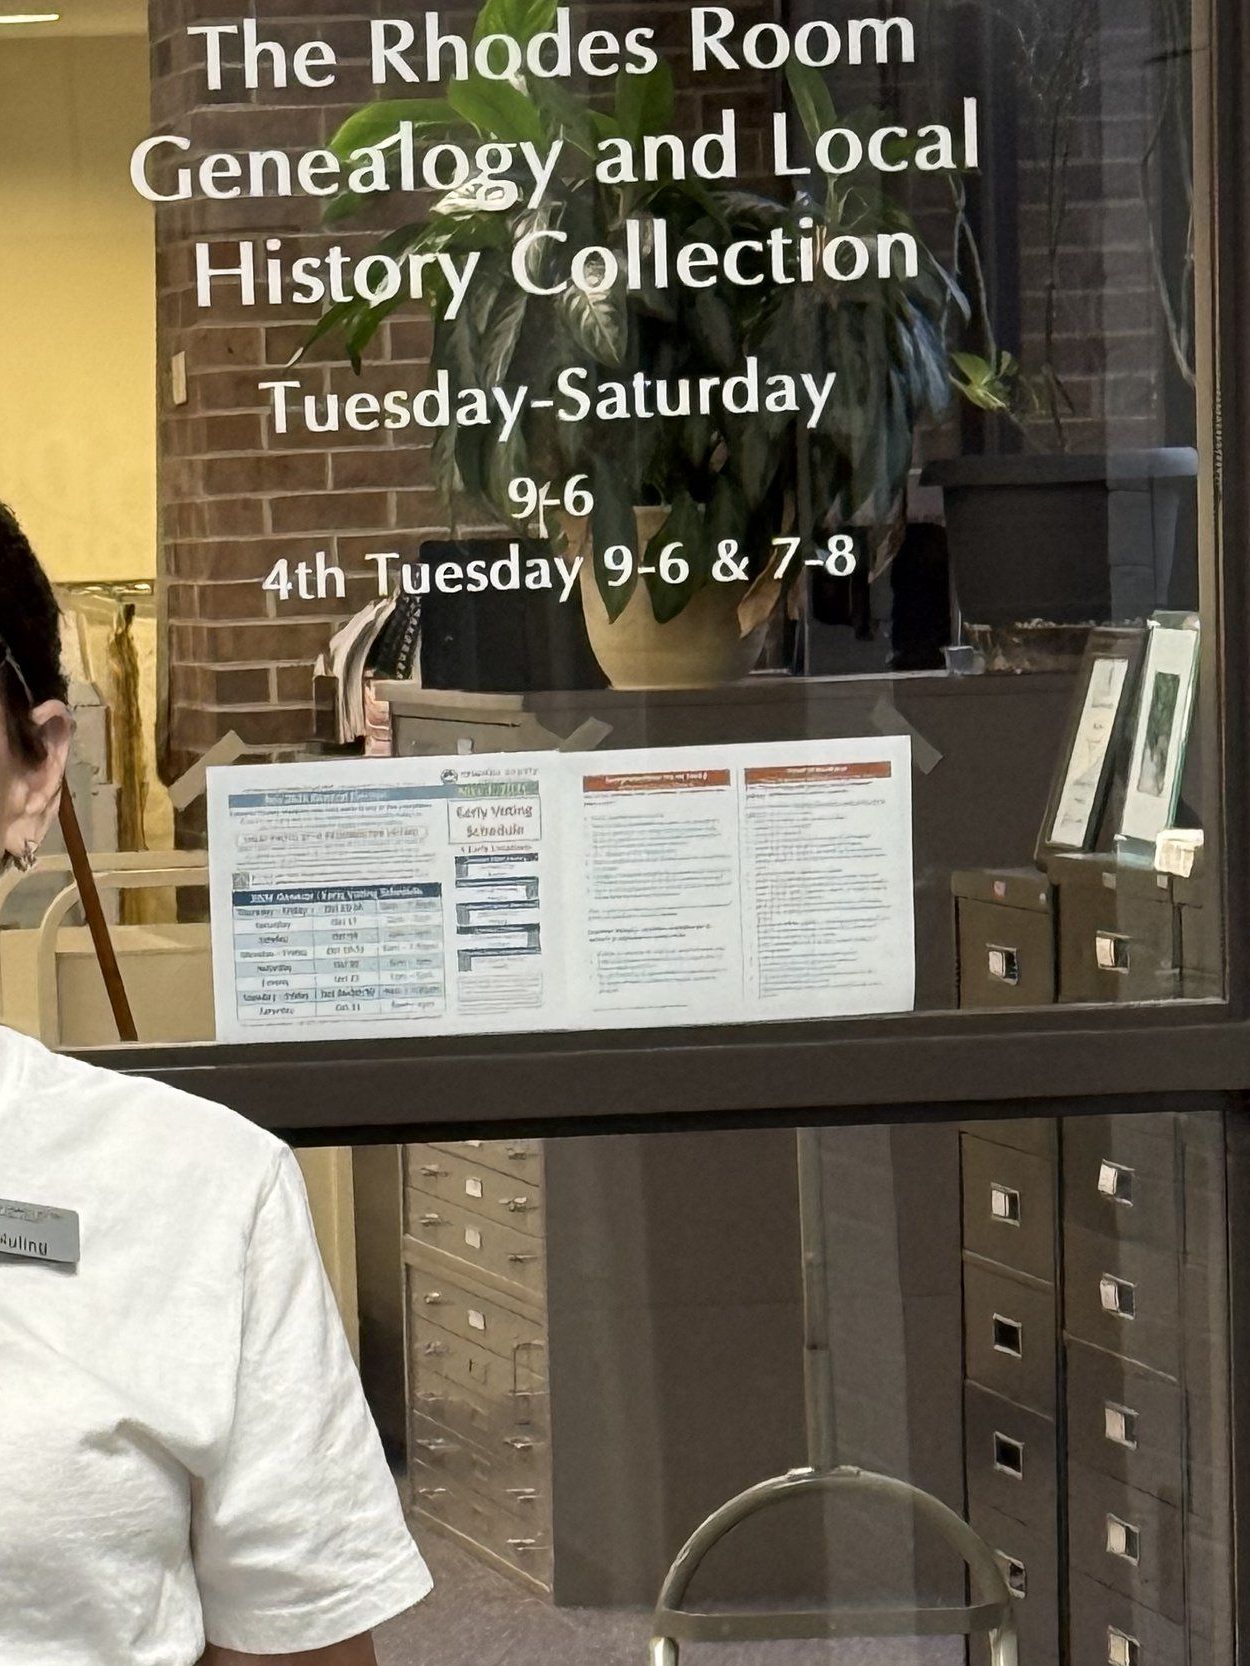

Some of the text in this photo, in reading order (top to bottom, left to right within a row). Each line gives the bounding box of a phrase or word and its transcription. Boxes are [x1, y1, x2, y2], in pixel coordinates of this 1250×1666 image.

[187, 6, 916, 90] The Rhodes Room
[130, 97, 979, 212] Genealogy and Local
[195, 217, 919, 321] History Collection
[258, 356, 837, 443] Tuesday-Saturday
[507, 474, 594, 521] 9-6
[261, 534, 857, 602] 4th Tuesday 9-6 & 7-8
[456, 806, 488, 820] Early
